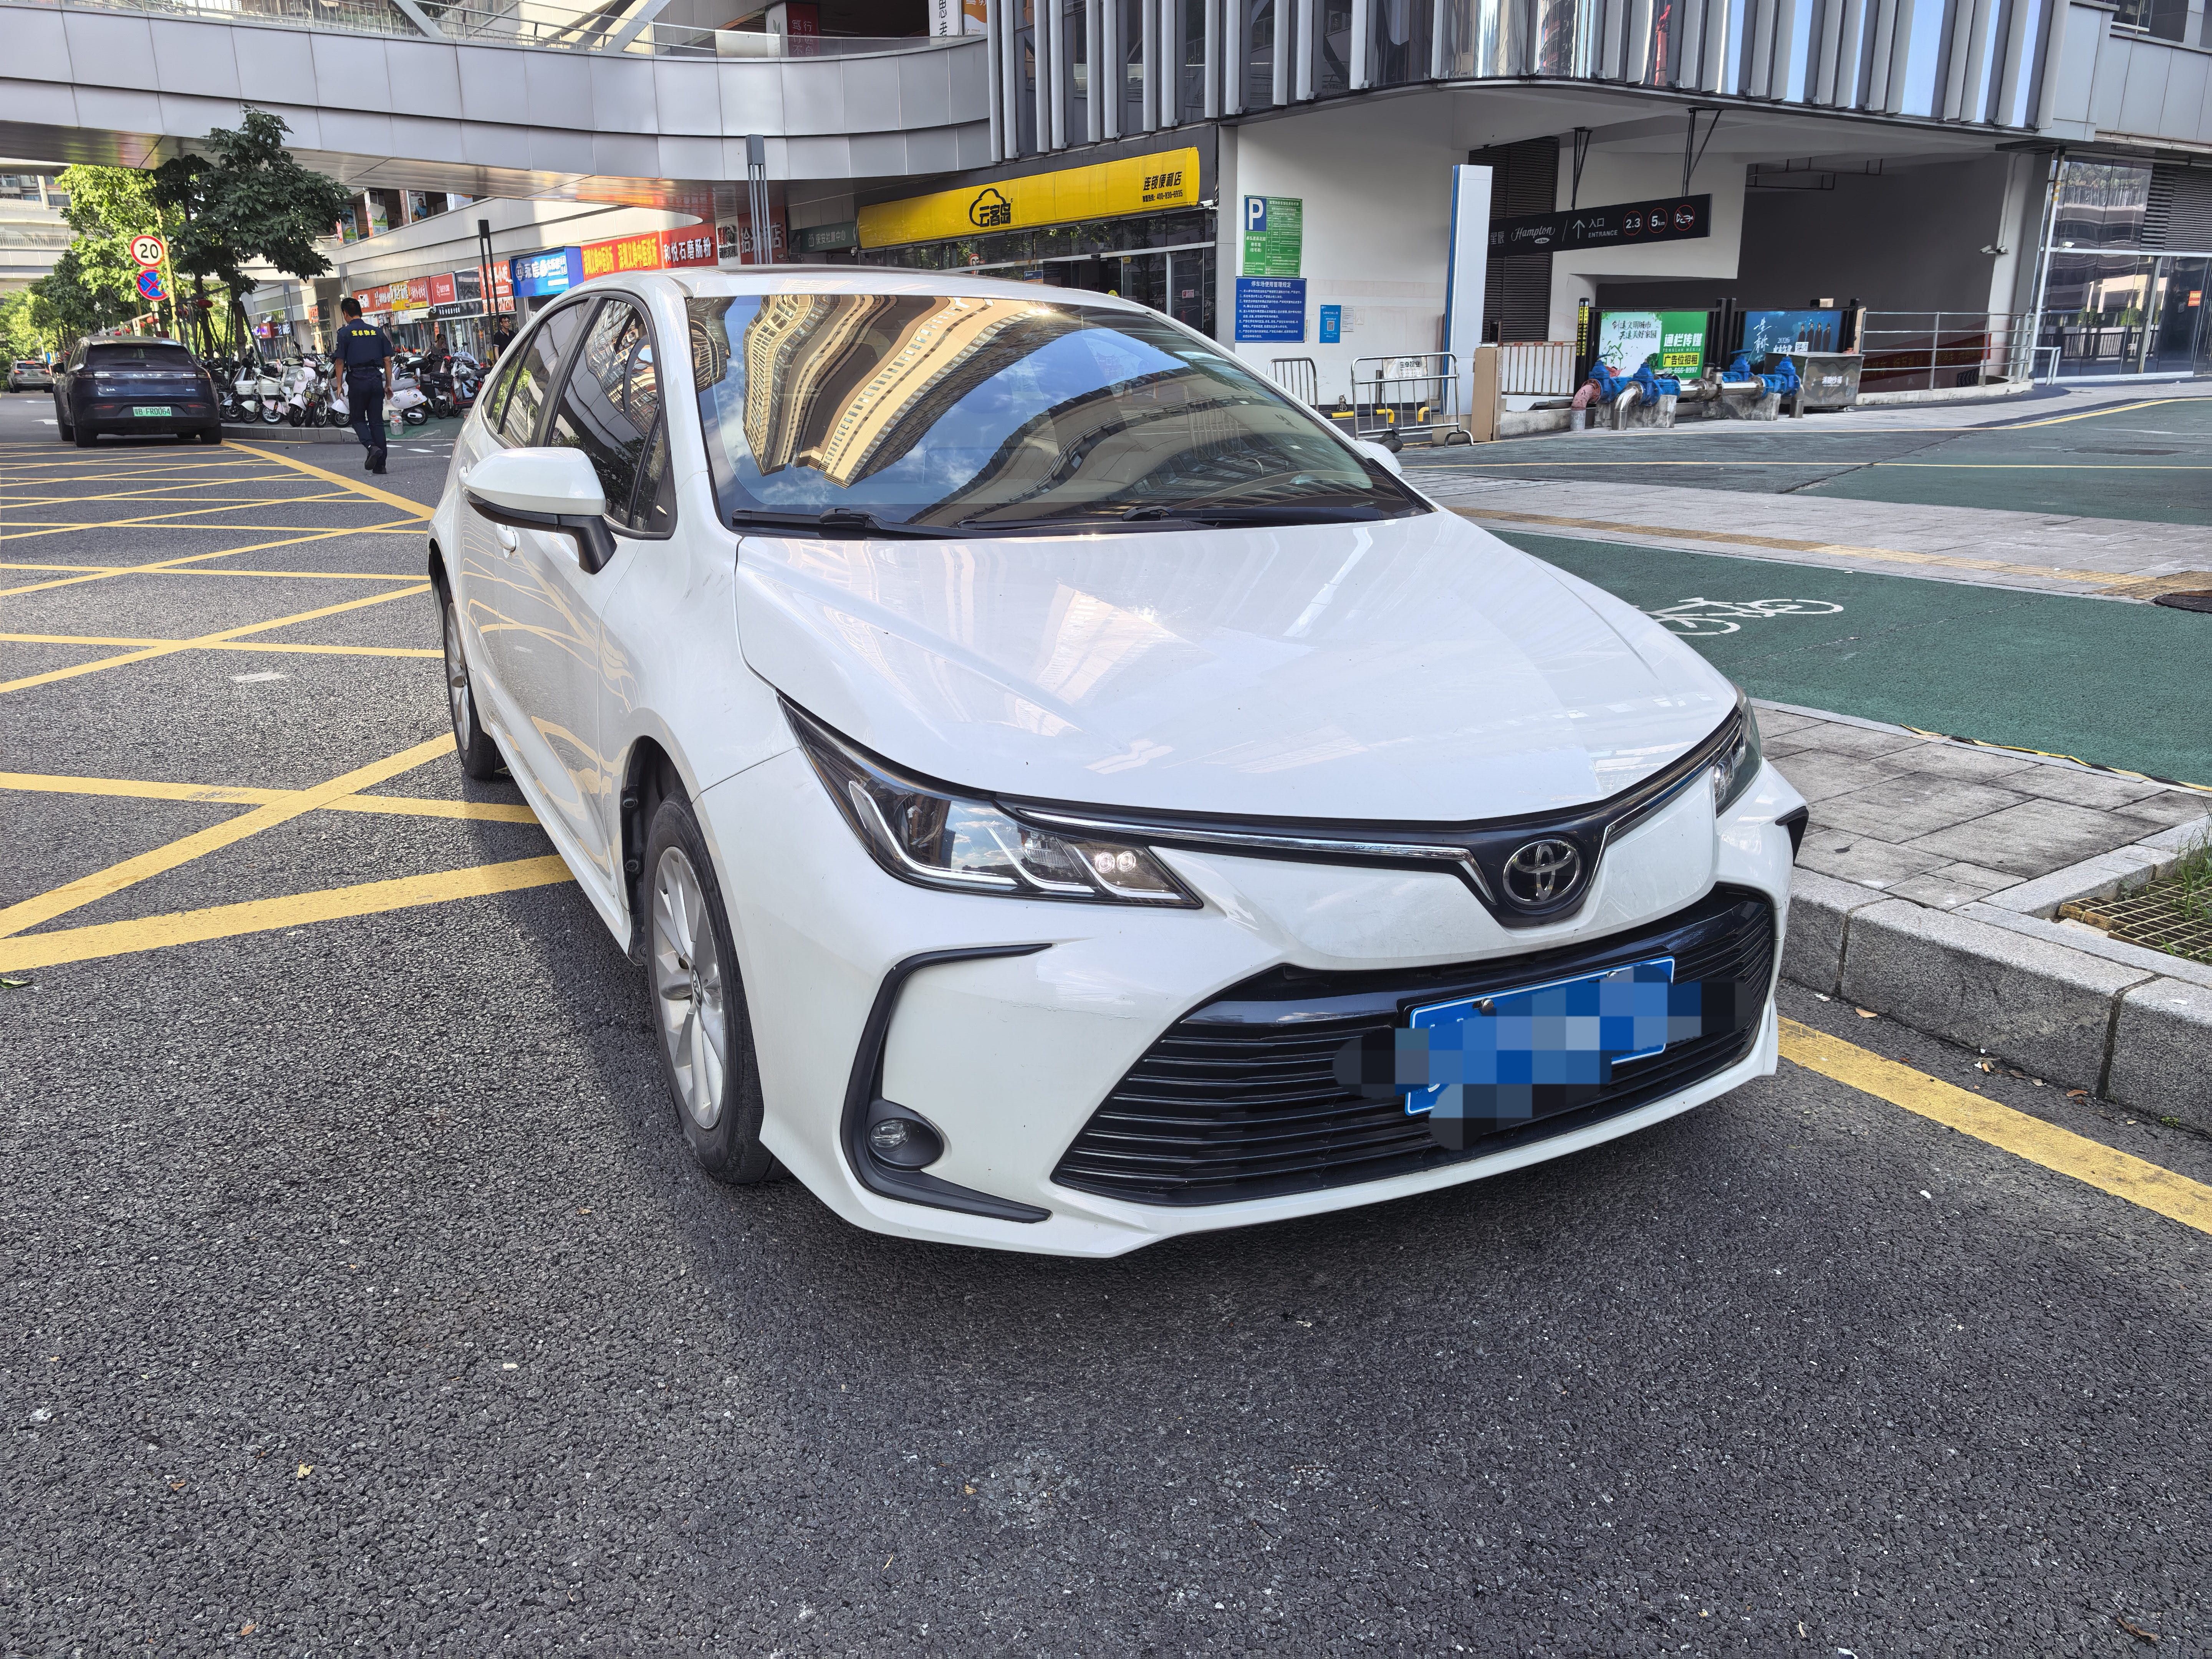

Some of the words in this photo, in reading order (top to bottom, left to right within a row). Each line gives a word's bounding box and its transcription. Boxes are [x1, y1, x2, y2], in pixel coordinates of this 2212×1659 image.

[1143, 171, 1182, 191] 连锁便利店
[1248, 198, 1263, 230] P
[1589, 218, 1604, 228] 入口
[1626, 218, 1641, 228] 2.3
[1511, 225, 1555, 241] Hampton
[1588, 230, 1618, 238] ENTRANCE
[139, 243, 159, 258] 20
[663, 236, 711, 263] 和悦石磨肠粉
[1664, 333, 1703, 347] 通栏传媒
[1664, 355, 1698, 365] 广告位招租
